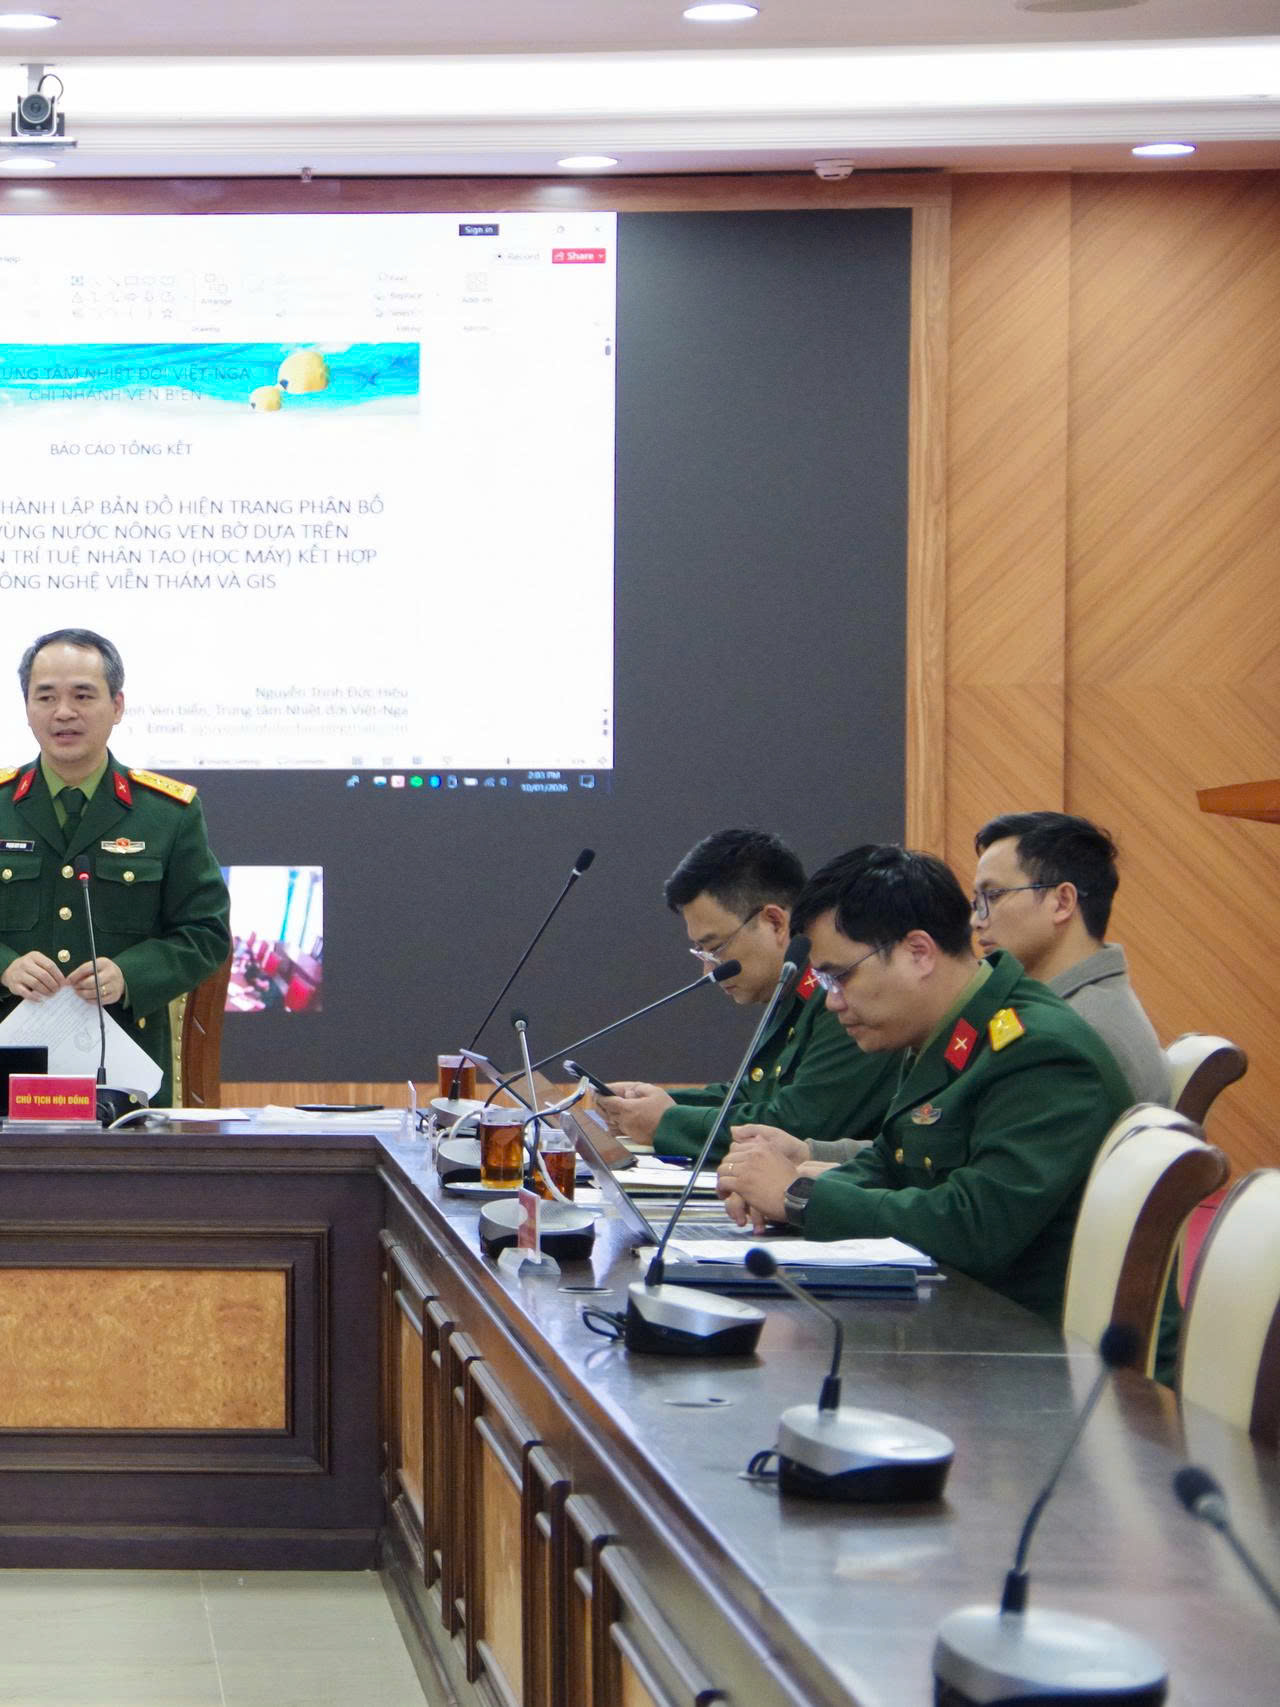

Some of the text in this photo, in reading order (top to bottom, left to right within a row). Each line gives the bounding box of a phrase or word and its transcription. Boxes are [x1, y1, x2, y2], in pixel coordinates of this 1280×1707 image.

[464, 225, 483, 236] Sign
[566, 250, 595, 261] Share
[43, 363, 79, 381] TÂM
[28, 387, 57, 401] CHI
[49, 439, 193, 456] BÁO CÁO TỔNG KẾT
[100, 493, 139, 515] BẢN
[145, 493, 173, 515] ĐỒ
[299, 495, 352, 515] PHÂN
[358, 492, 385, 515] BỐ
[51, 520, 110, 540] NƯỚC
[115, 520, 172, 540] NÔNG
[177, 523, 215, 540] VEN
[221, 520, 249, 540] BỜ
[301, 519, 350, 540] TRÊN
[13, 544, 41, 565] TRÍ
[47, 544, 82, 568] TUỆ
[87, 544, 142, 565] NHÂN
[245, 544, 292, 568] MÁY)
[298, 543, 333, 565] KẾT
[337, 548, 378, 568] HỢP
[106, 567, 149, 590] VIỄN
[154, 569, 212, 590] THÁM
[217, 569, 242, 590] VÀ
[245, 574, 278, 590] GIS
[255, 684, 306, 701] Nguyễn
[215, 703, 253, 719] Trung
